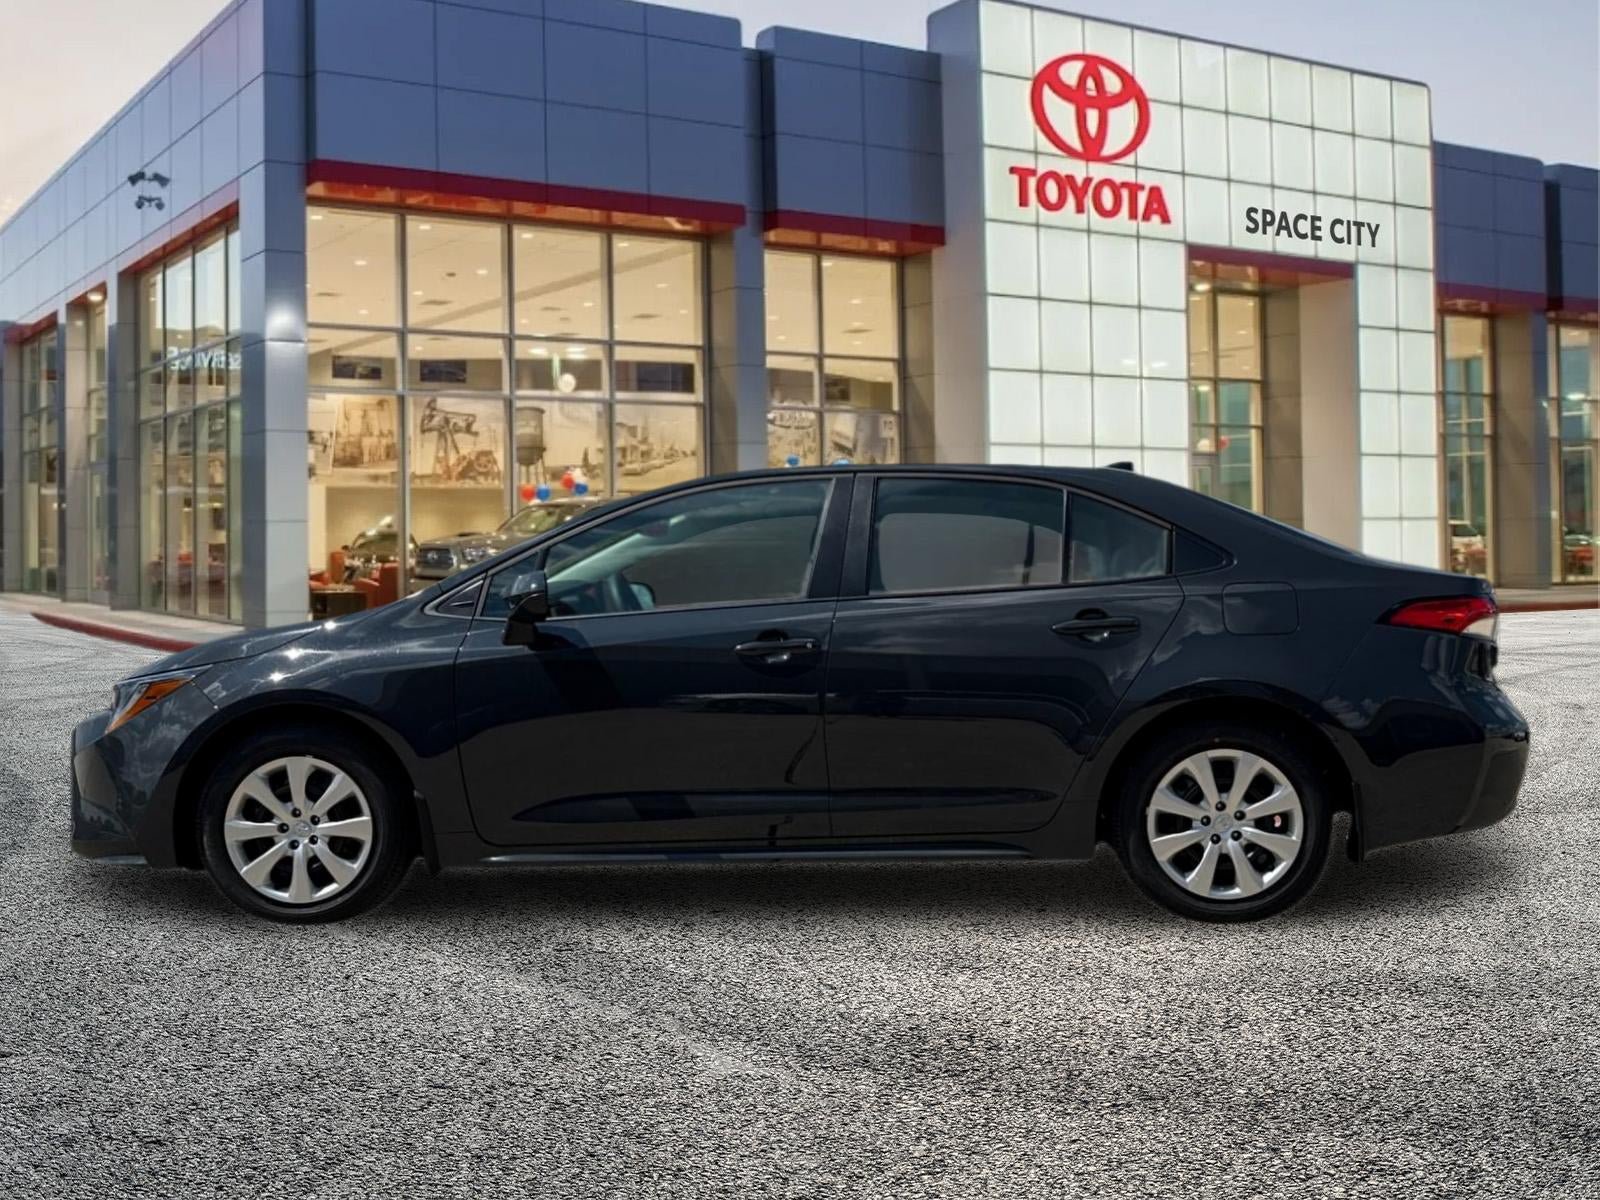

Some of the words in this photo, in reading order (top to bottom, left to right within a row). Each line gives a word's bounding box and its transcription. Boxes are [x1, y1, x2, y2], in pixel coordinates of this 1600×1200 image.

[1009, 166, 1171, 224] TOYOTA
[1245, 207, 1322, 242] SPACE
[1329, 218, 1380, 248] CITY
